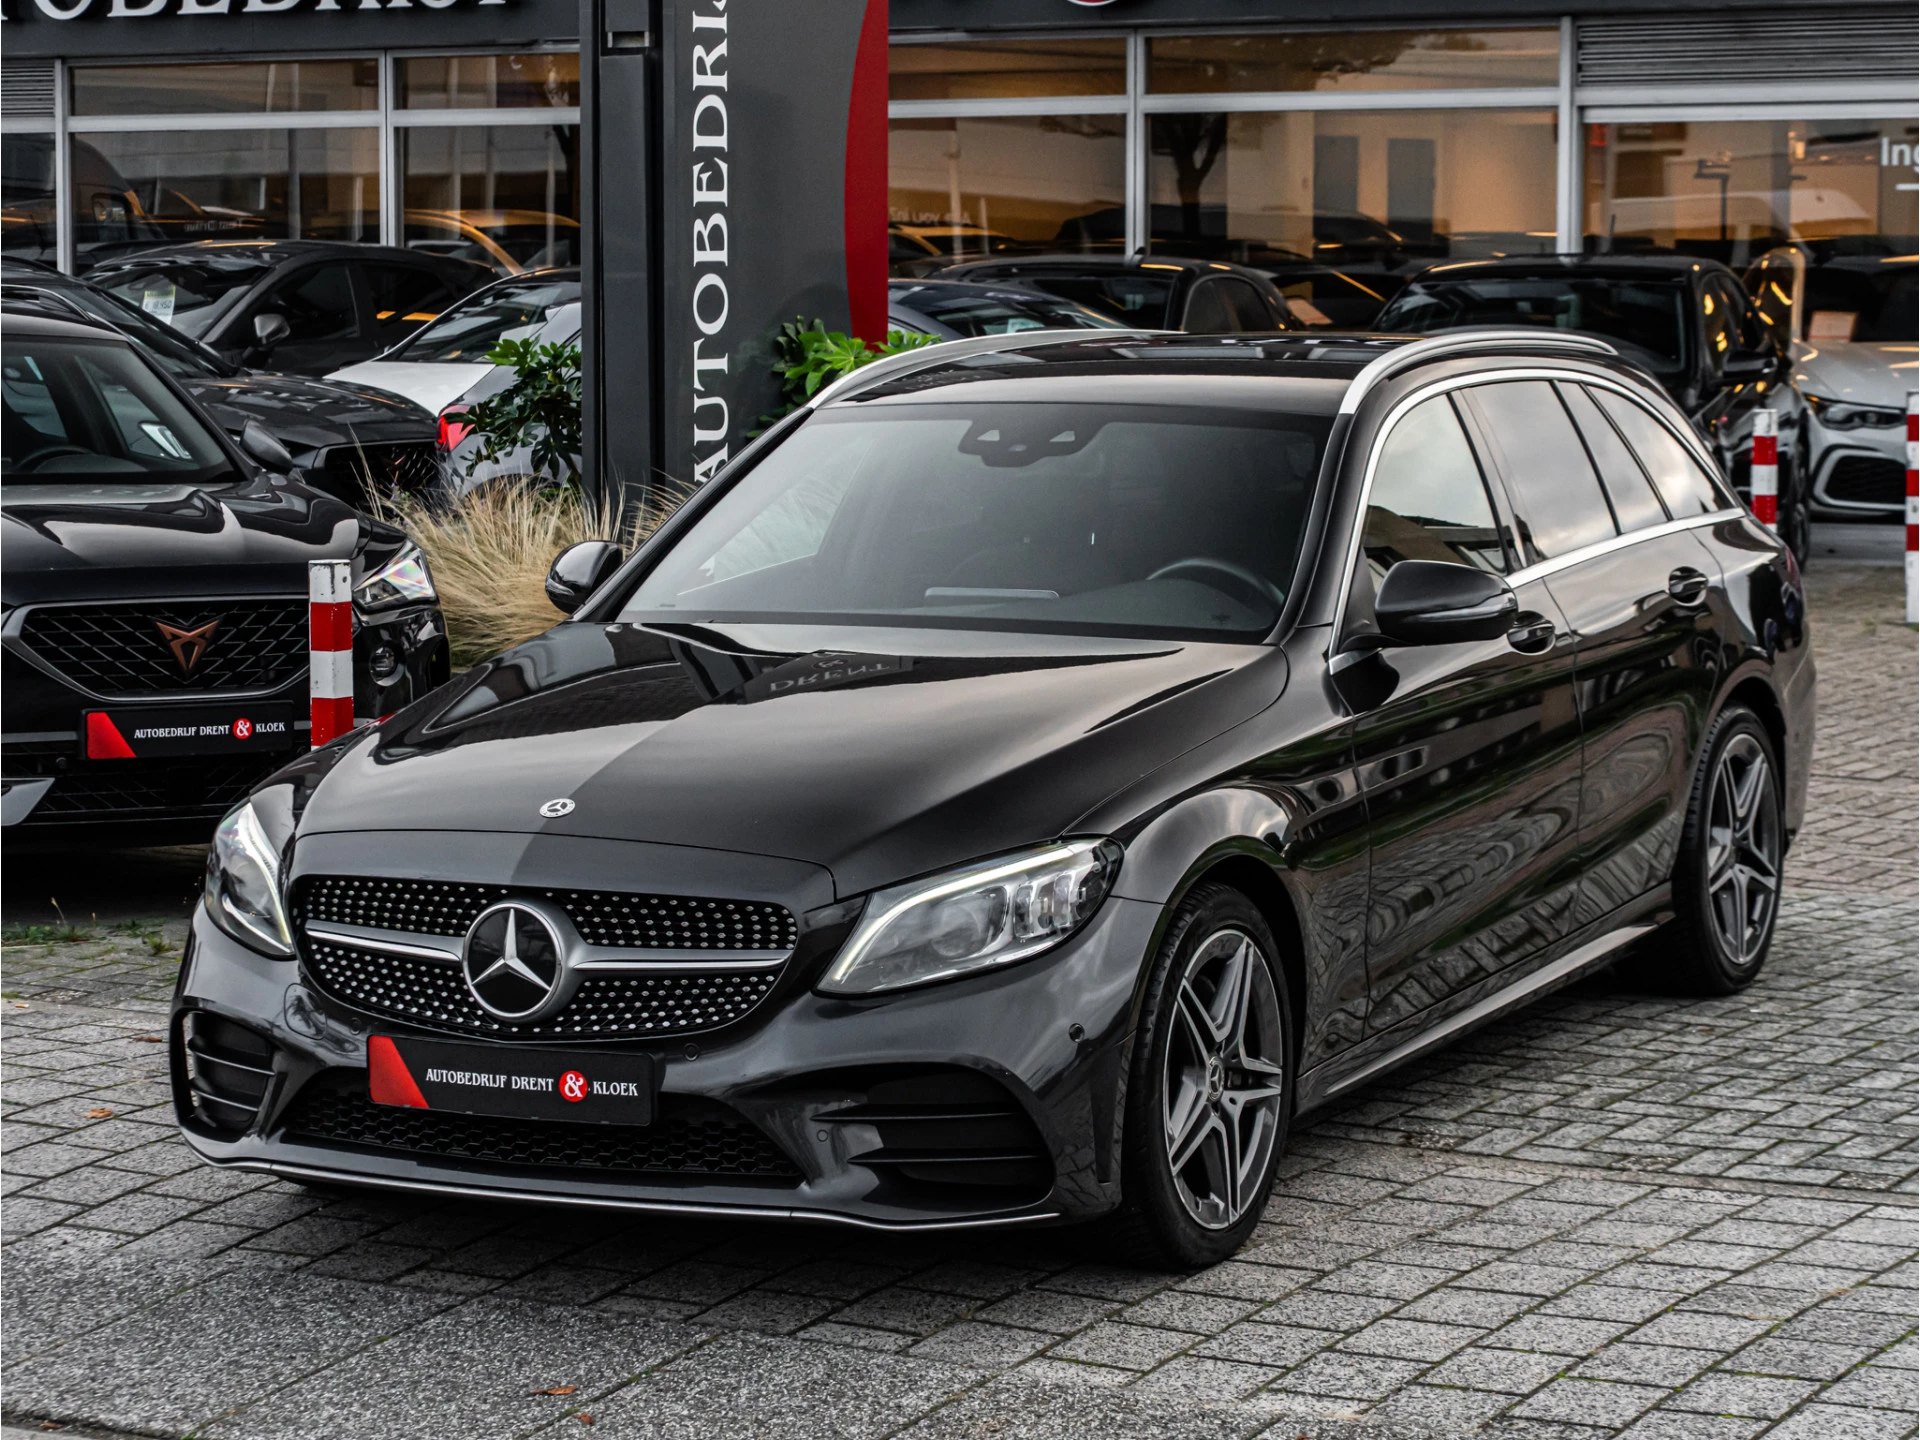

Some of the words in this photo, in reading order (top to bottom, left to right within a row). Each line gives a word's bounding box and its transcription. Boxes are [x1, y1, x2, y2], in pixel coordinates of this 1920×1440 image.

[692, 0, 729, 482] AUTOBEDRI
[134, 727, 197, 739] AUTOBEDRIJF
[199, 724, 230, 736] DRENT
[236, 719, 250, 737] &
[255, 721, 286, 733] KLOEK
[425, 1068, 508, 1089] AUTOBEDRIJF
[511, 1076, 554, 1091] DRENT
[563, 1073, 584, 1098] &
[593, 1081, 639, 1097] KLOEK
